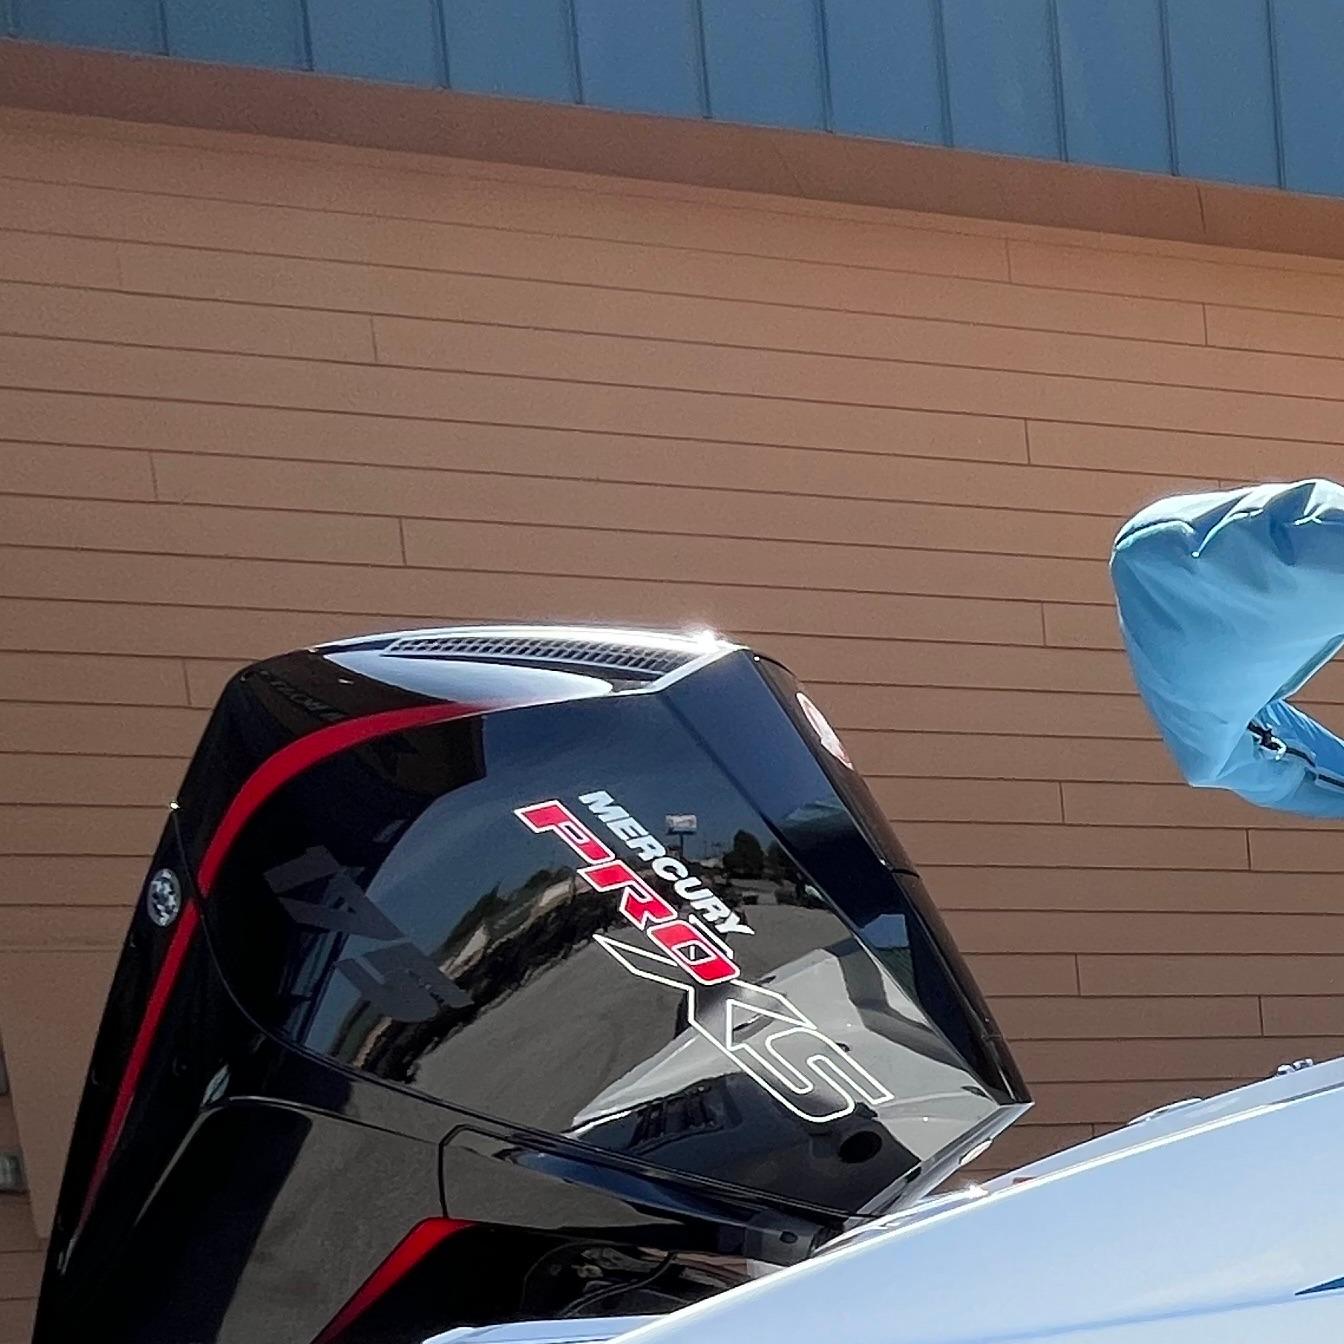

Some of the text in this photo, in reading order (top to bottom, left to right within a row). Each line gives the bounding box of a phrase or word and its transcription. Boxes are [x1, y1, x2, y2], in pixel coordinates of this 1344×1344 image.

[513, 799, 741, 986] PRO
[579, 790, 755, 937] MERCURY
[593, 913, 895, 1123] XS
